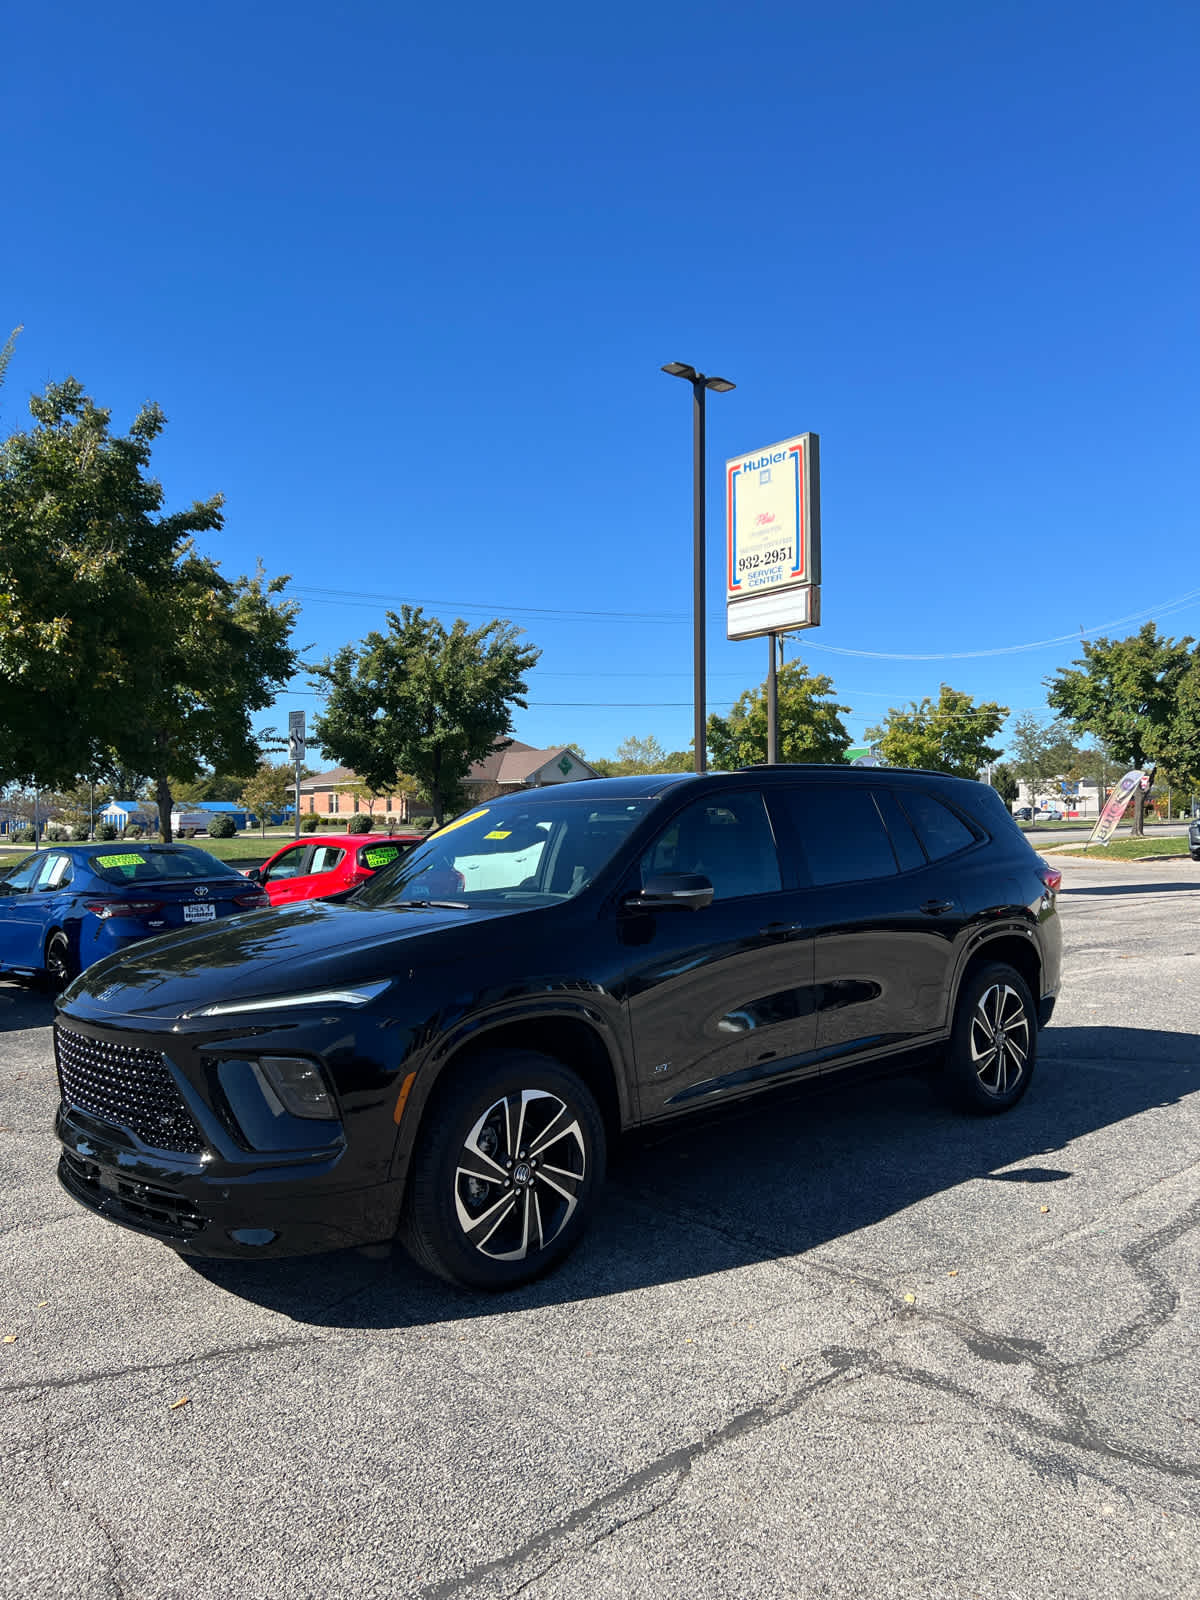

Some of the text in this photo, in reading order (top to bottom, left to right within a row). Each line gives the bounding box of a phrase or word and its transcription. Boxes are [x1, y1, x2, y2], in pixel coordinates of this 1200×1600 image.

[743, 451, 787, 472] Hubler
[738, 546, 793, 572] 932-2951
[747, 565, 784, 580] SERVICE
[748, 574, 783, 588] CENTER
